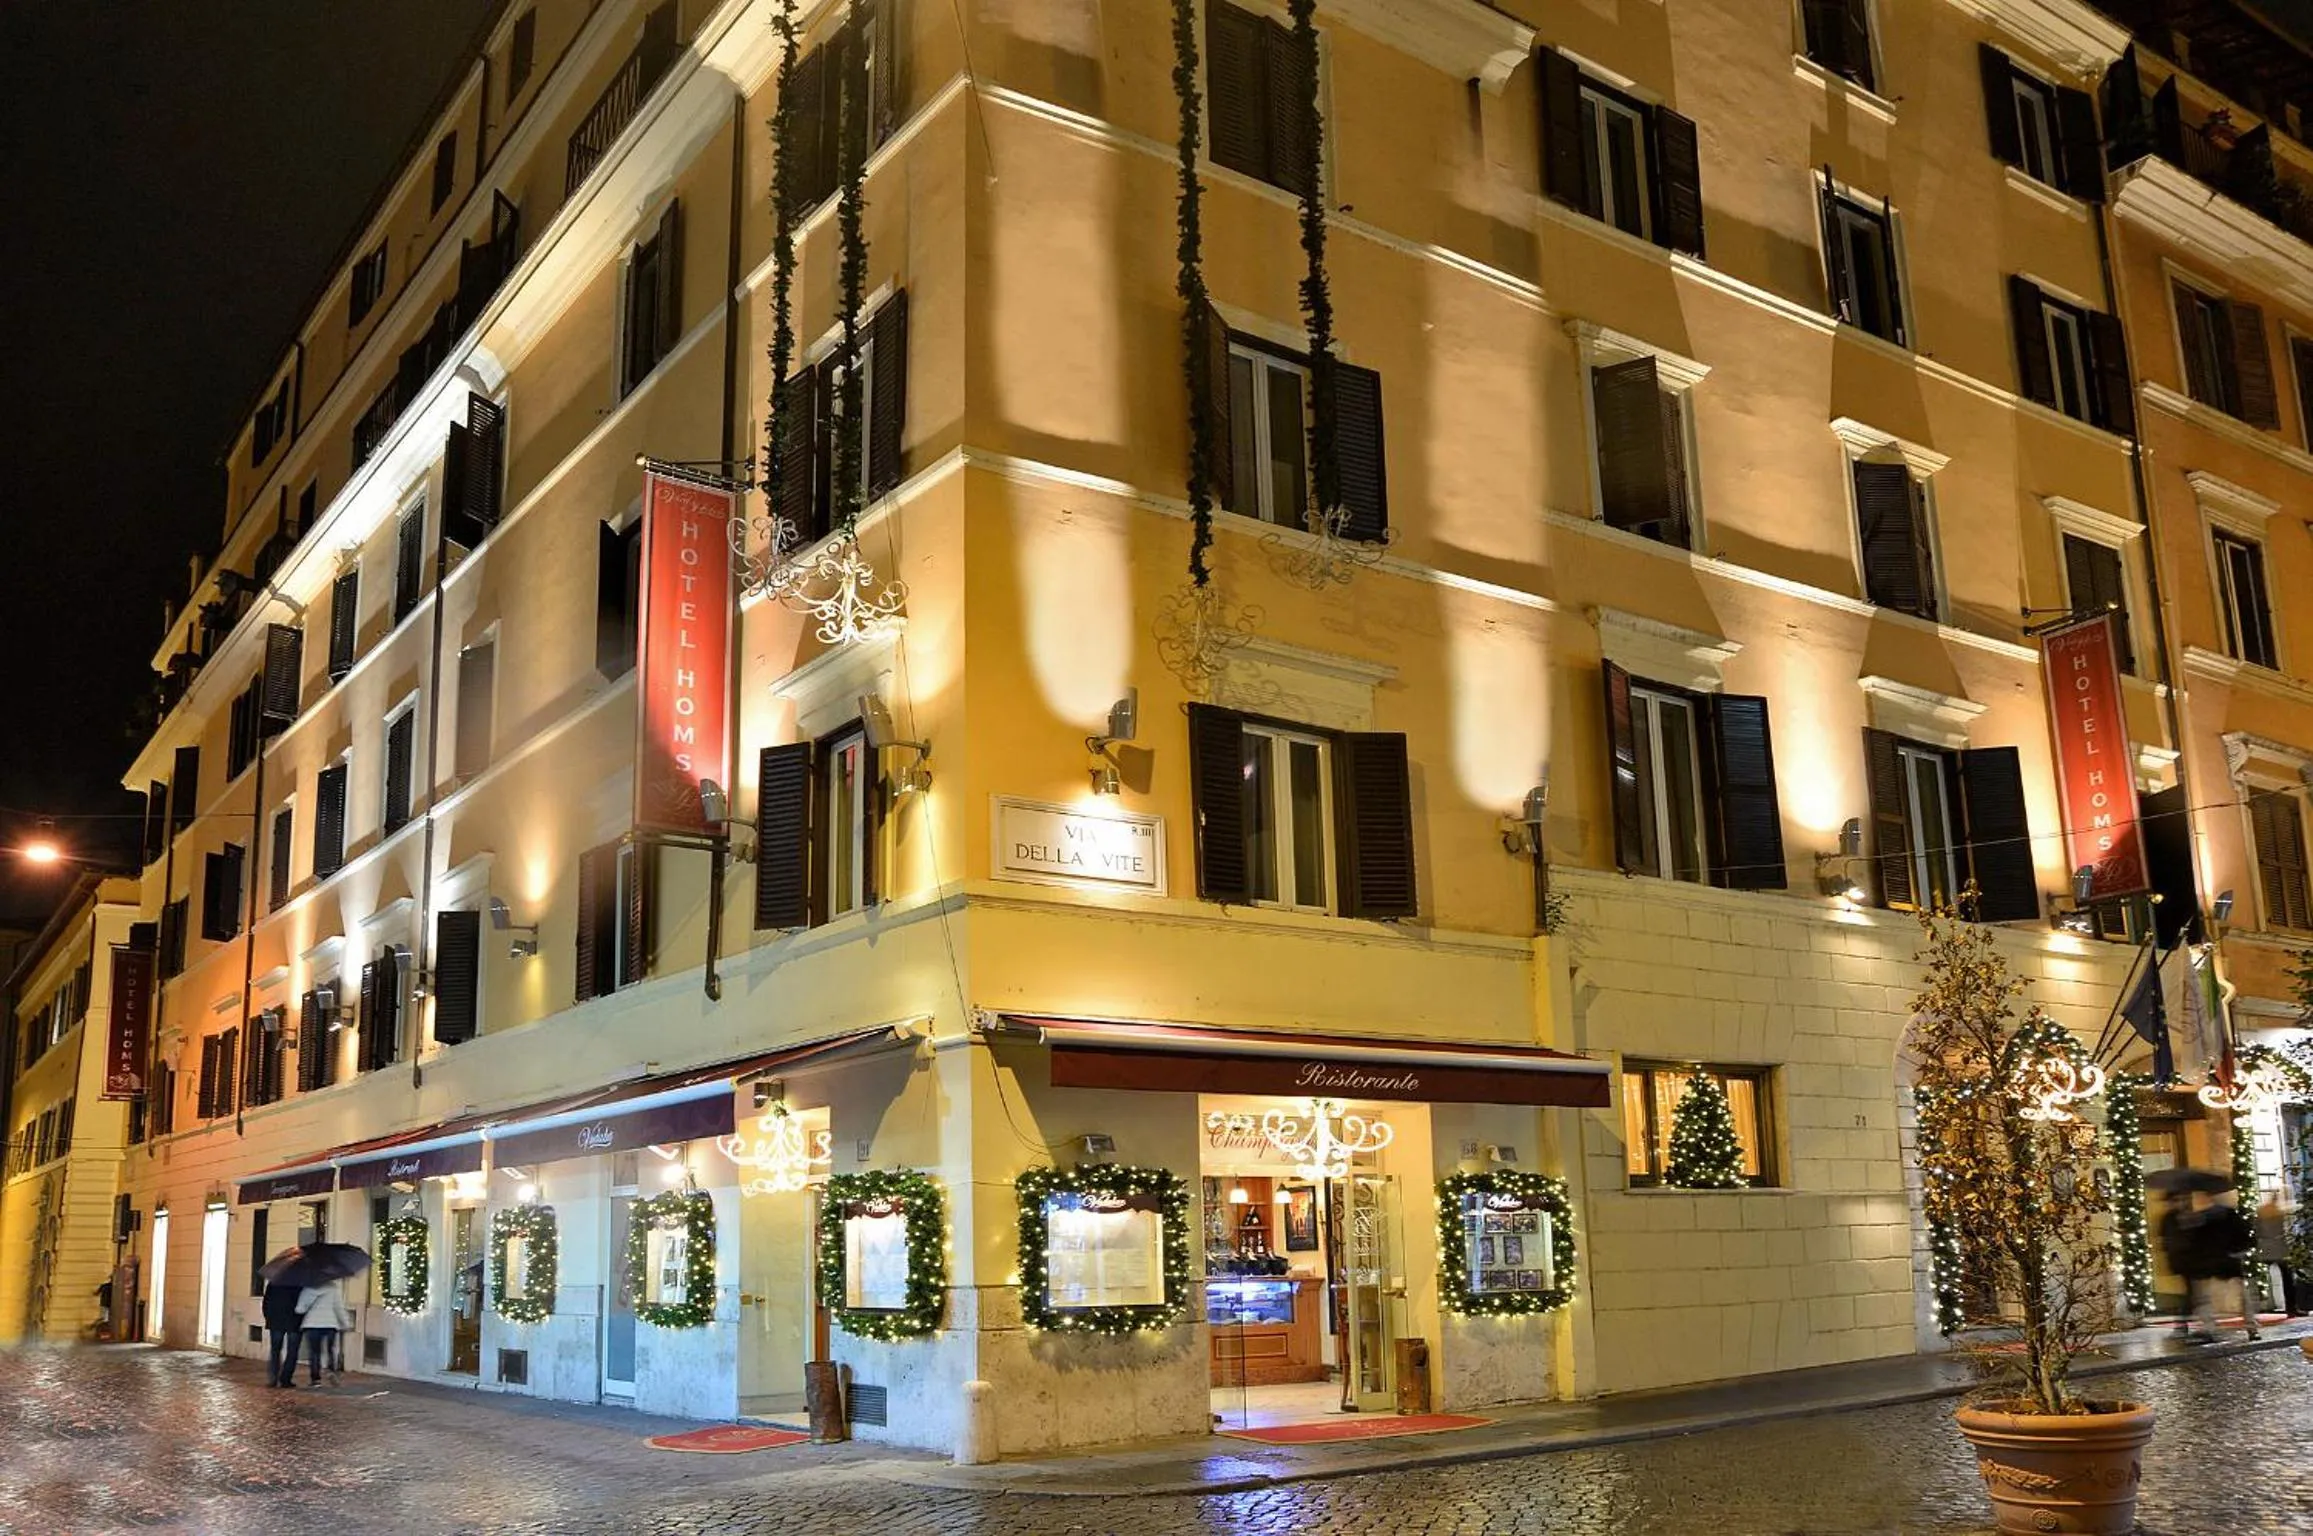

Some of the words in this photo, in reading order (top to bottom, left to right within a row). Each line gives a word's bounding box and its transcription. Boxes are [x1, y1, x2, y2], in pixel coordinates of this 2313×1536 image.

[680, 520, 698, 649] HOTEL
[673, 668, 696, 772] HOMS
[2073, 654, 2100, 755] HOTEL
[2088, 770, 2113, 852] HOMS
[1016, 843, 1084, 866] DELLA
[1102, 853, 1144, 872] VITE
[1065, 825, 1097, 844] VIA
[126, 966, 137, 1021] HOTEL
[121, 1029, 133, 1072] HOMS
[1296, 1061, 1419, 1092] Ristorante
